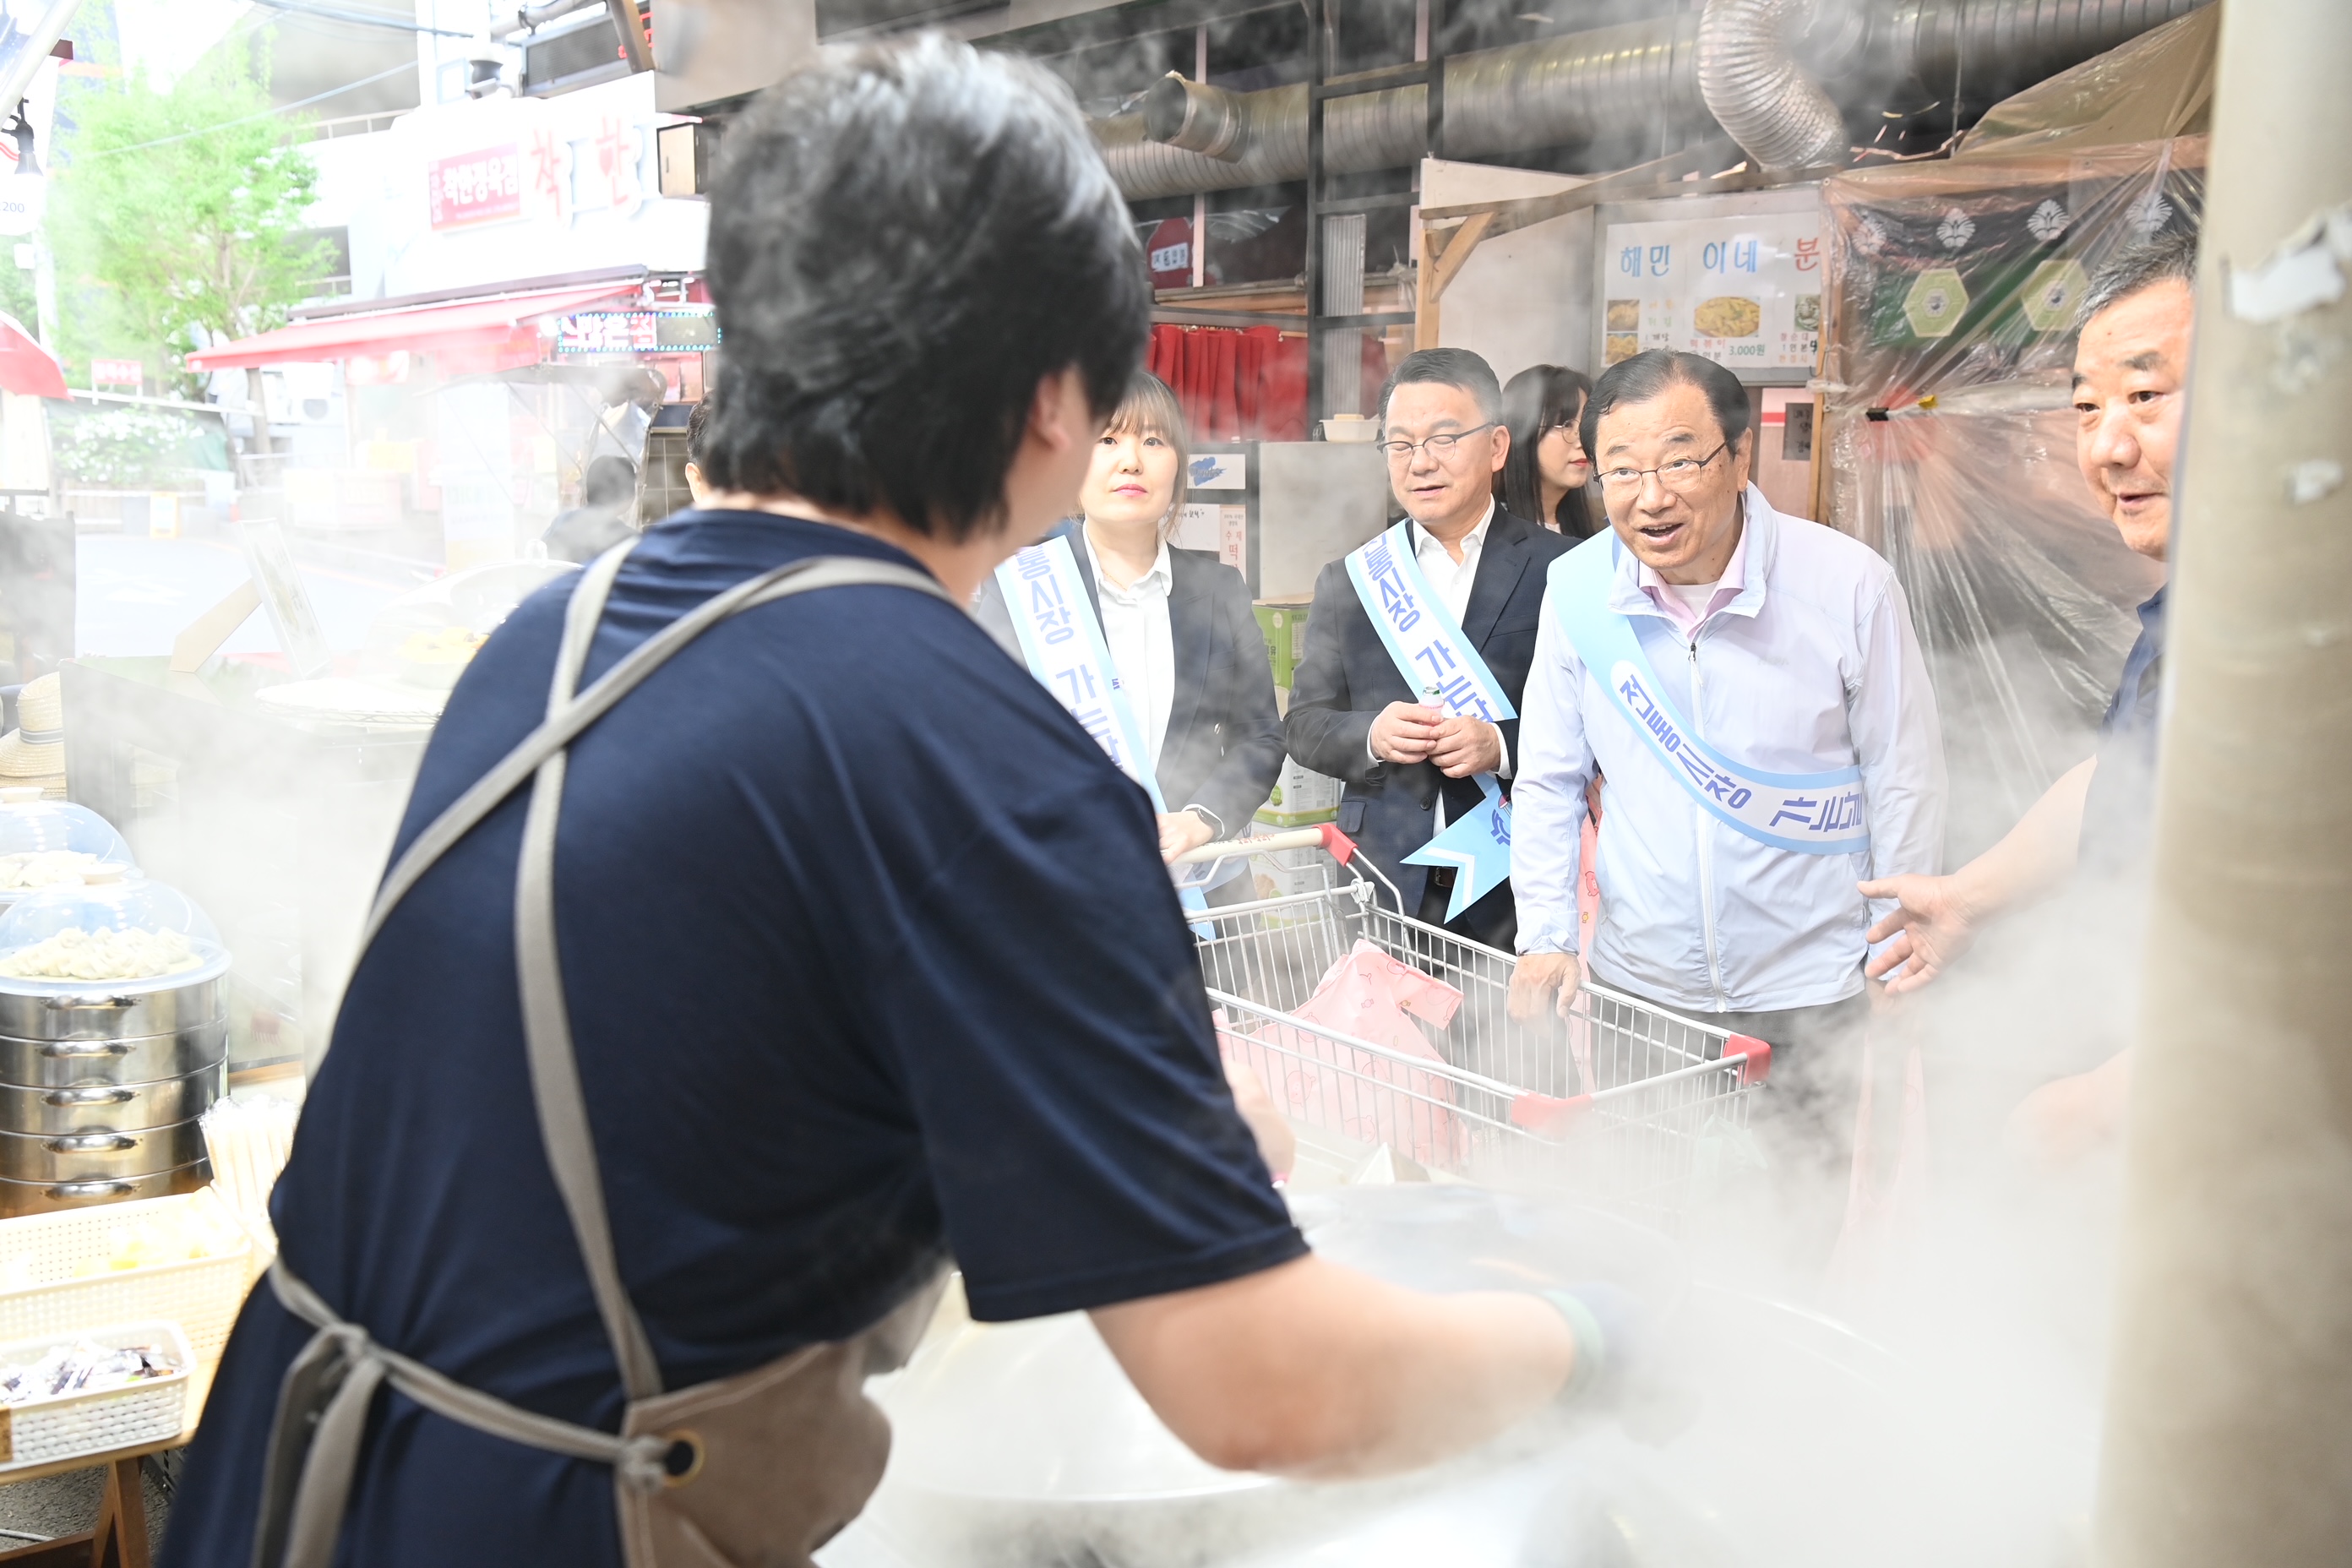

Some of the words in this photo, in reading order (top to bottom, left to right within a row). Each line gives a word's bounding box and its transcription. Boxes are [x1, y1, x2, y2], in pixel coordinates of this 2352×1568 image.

[0, 201, 24, 213] 200
[1620, 245, 1671, 278] 해민
[1702, 239, 1758, 275] 이네
[1794, 237, 1820, 272] 분
[1015, 545, 1074, 645] 통시장
[1620, 674, 1751, 808] 전통시장
